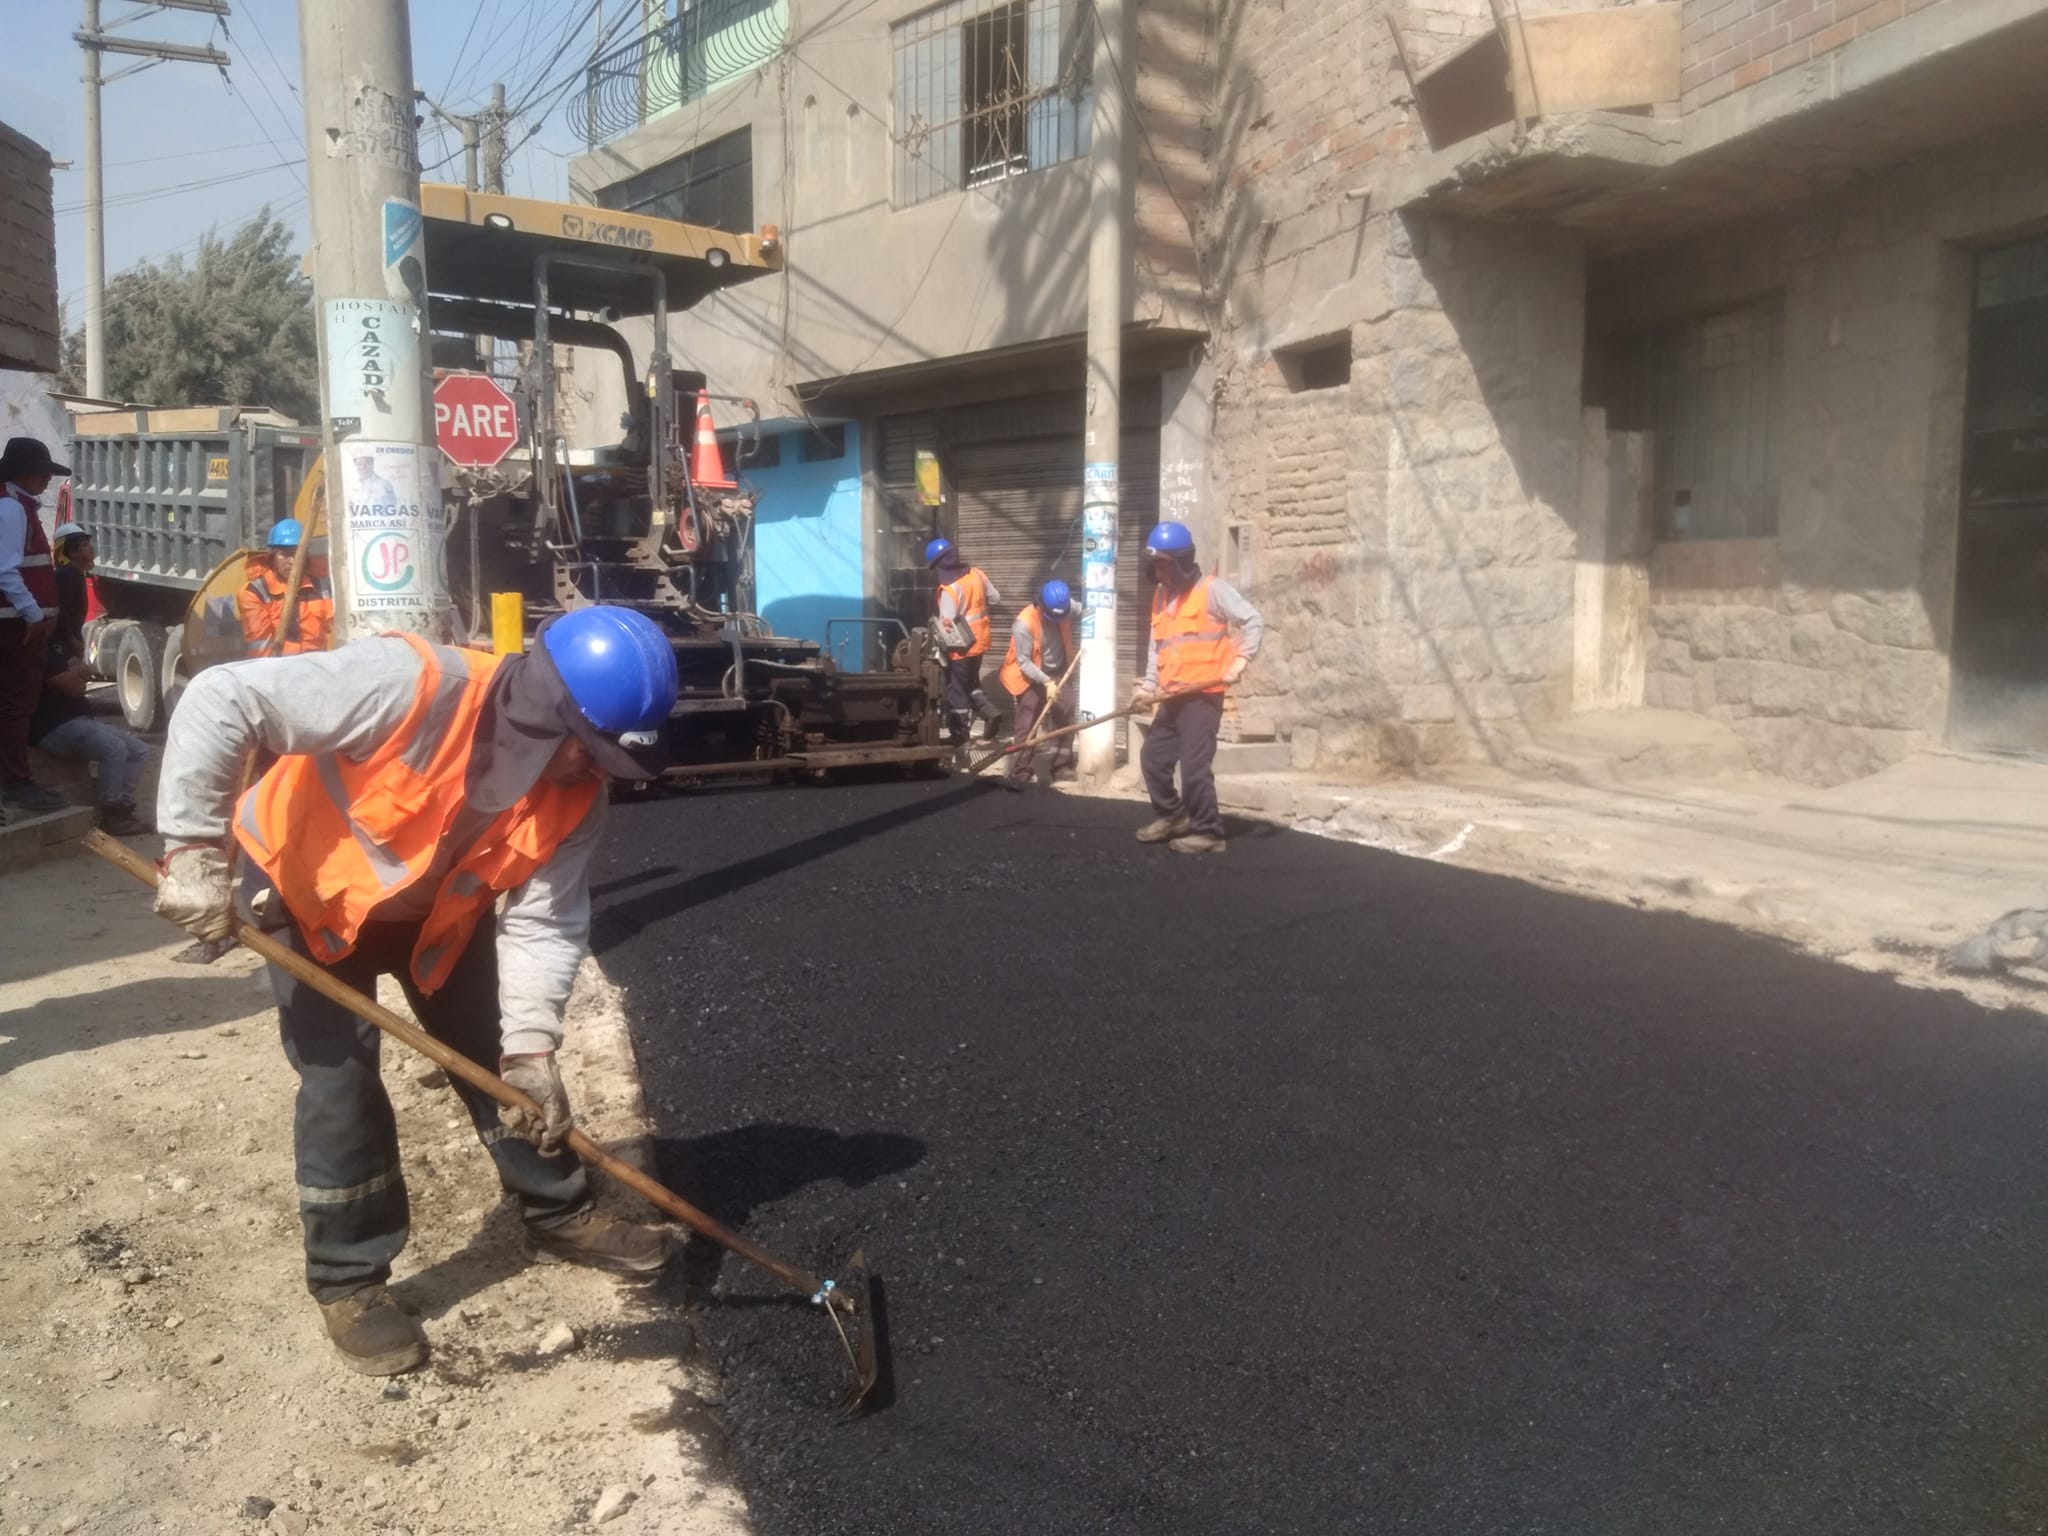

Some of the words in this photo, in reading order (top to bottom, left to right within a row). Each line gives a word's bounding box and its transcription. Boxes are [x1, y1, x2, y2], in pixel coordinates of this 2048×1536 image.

[586, 221, 654, 250] XCMG
[434, 403, 512, 438] PARE
[350, 504, 420, 517] VARGAS
[350, 519, 386, 528] MARCA
[358, 597, 423, 607] DISTRITAL
